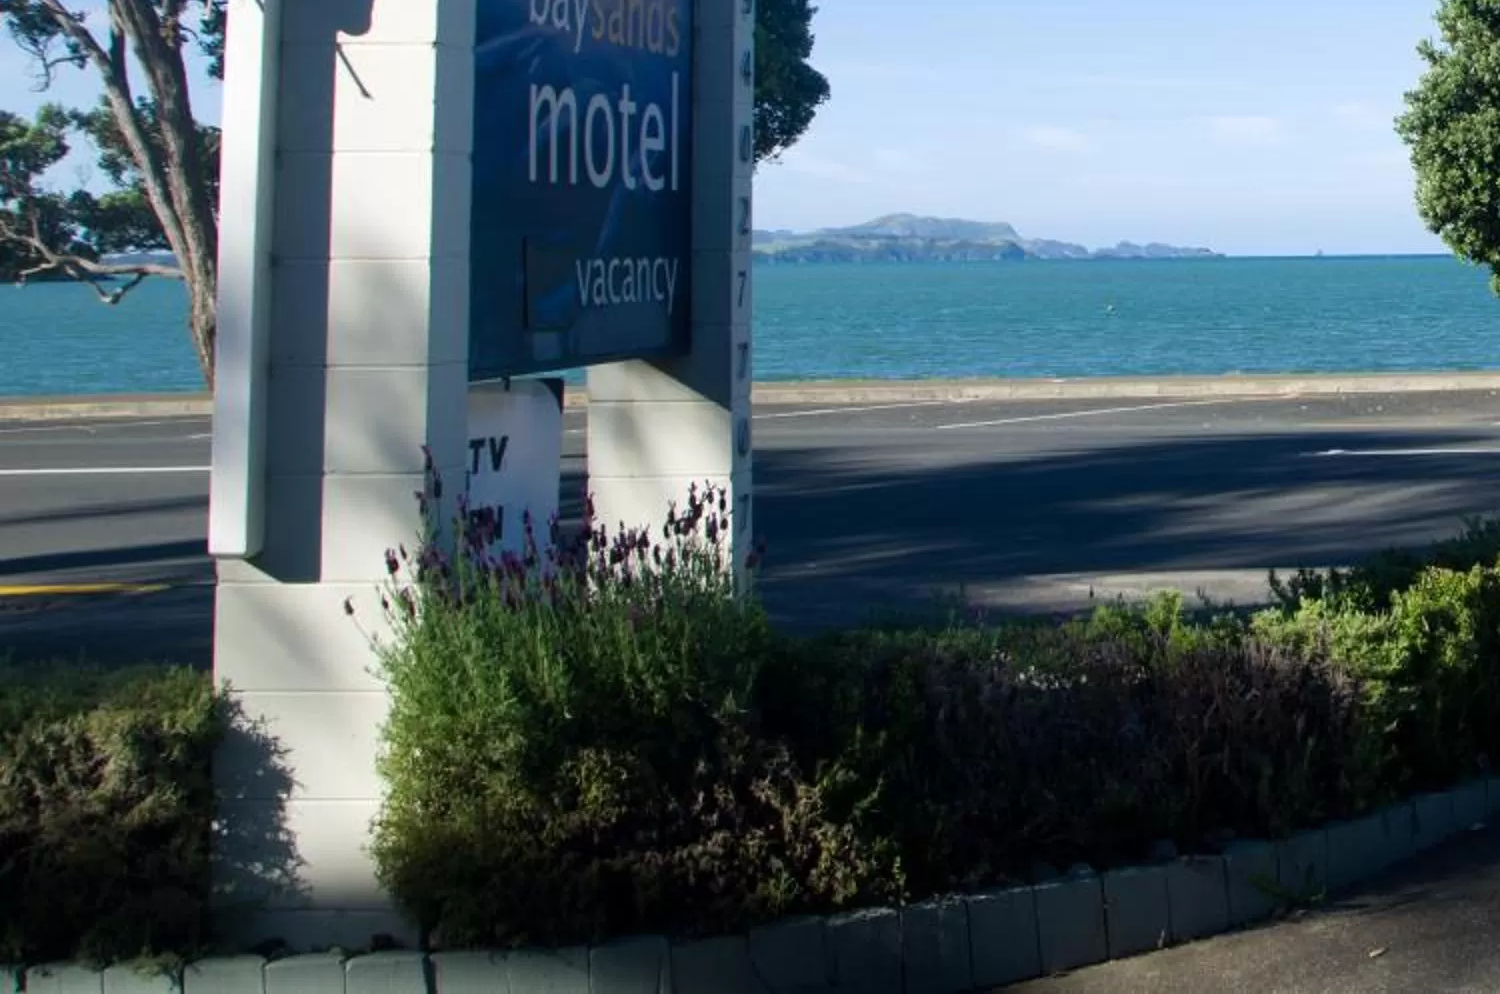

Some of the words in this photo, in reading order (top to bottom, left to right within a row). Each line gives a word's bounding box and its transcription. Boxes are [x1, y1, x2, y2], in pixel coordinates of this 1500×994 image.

[528, 71, 680, 191] motel
[576, 255, 679, 315] vacancy
[469, 435, 509, 475] TV
